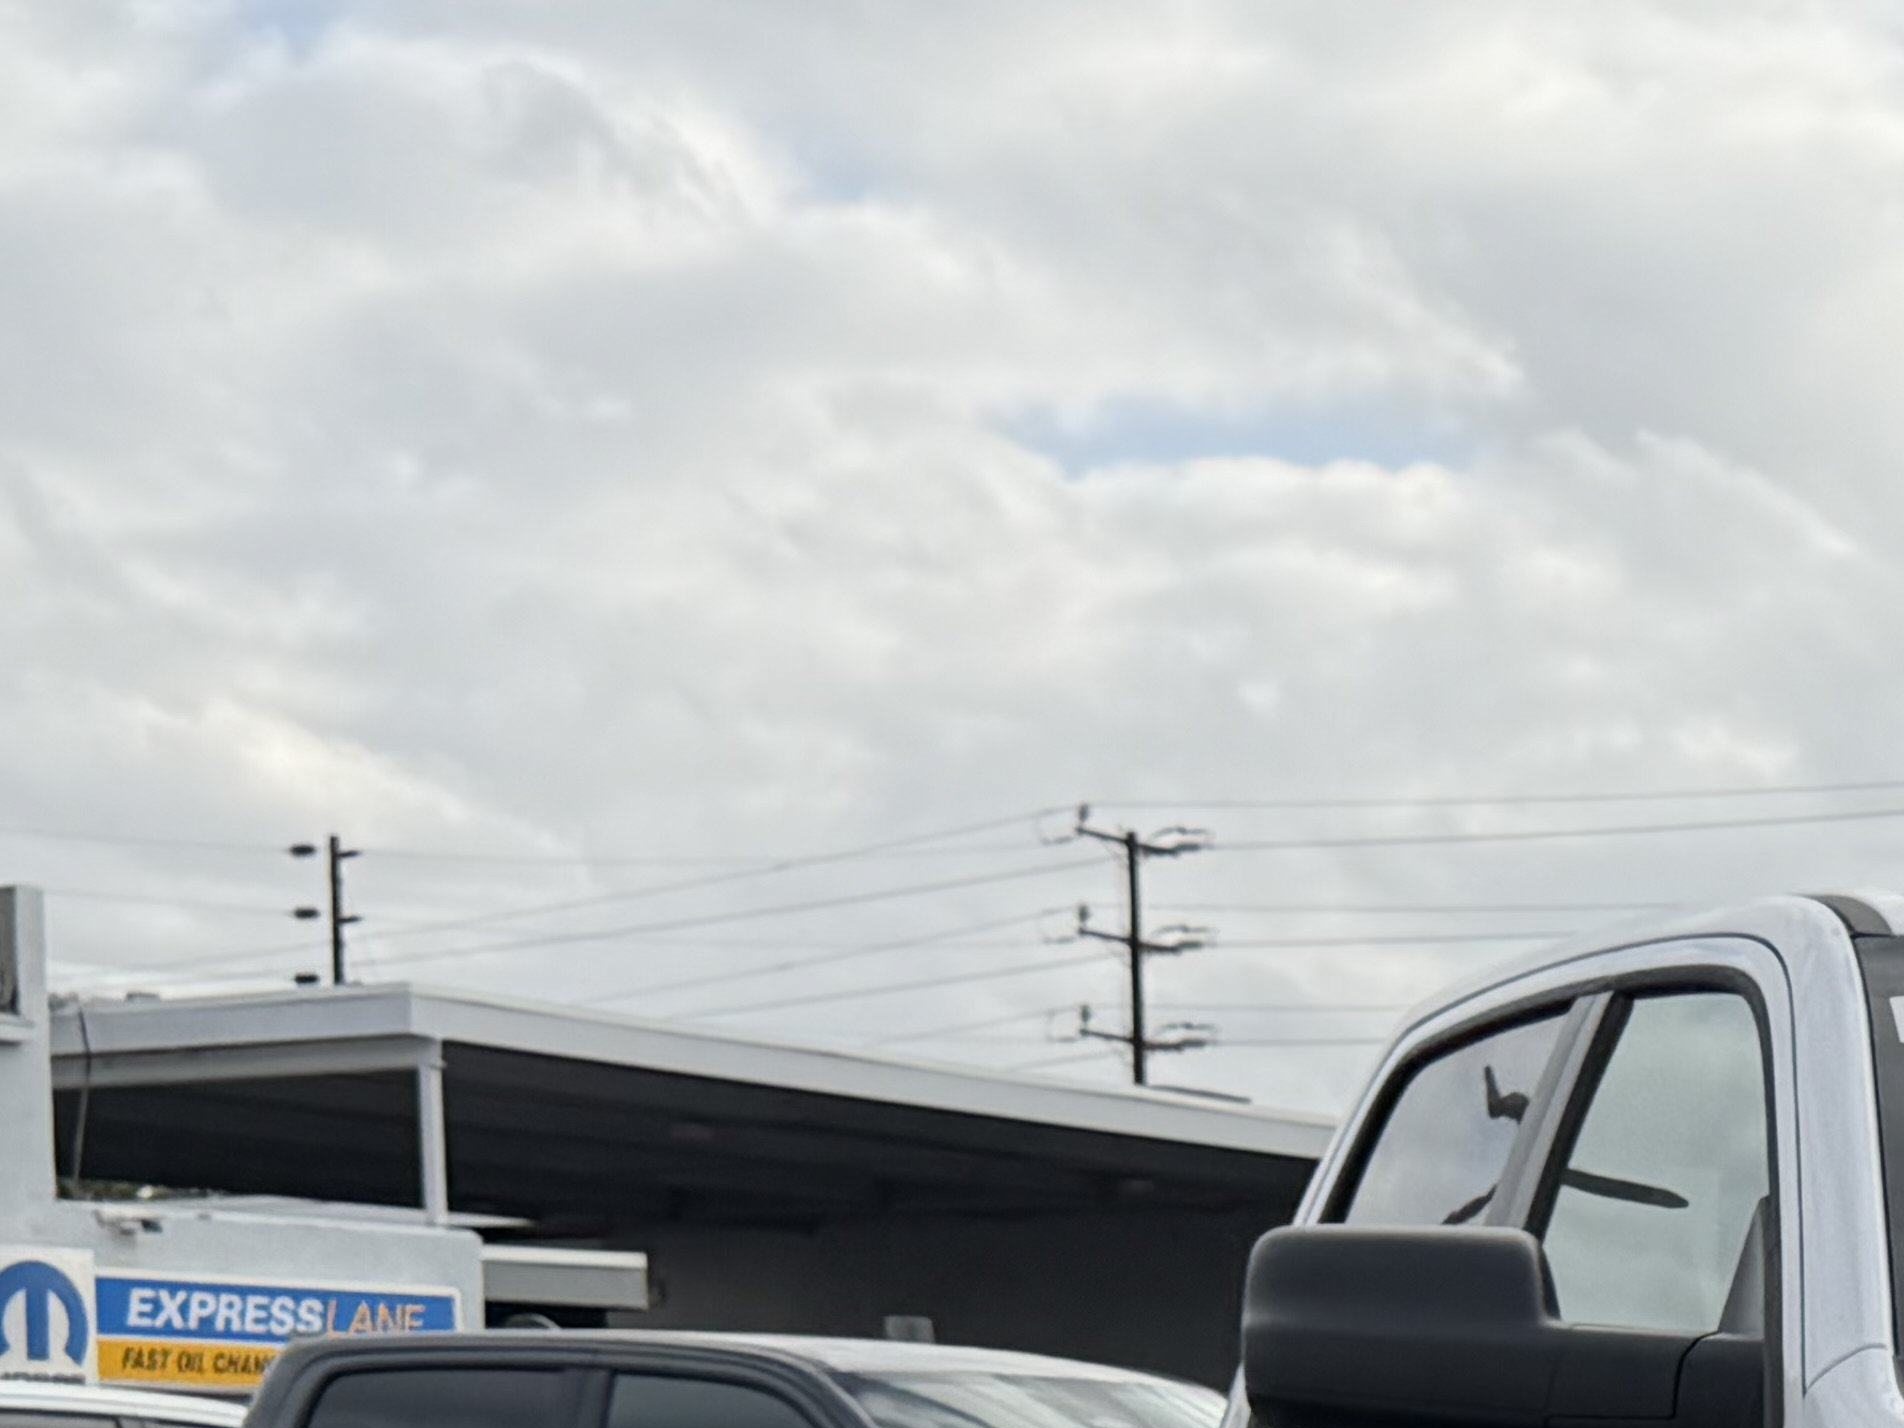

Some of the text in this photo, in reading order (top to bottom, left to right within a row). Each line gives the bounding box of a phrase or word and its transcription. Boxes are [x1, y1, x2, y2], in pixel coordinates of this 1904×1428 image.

[122, 1348, 276, 1374] FAST OIL CHAN
